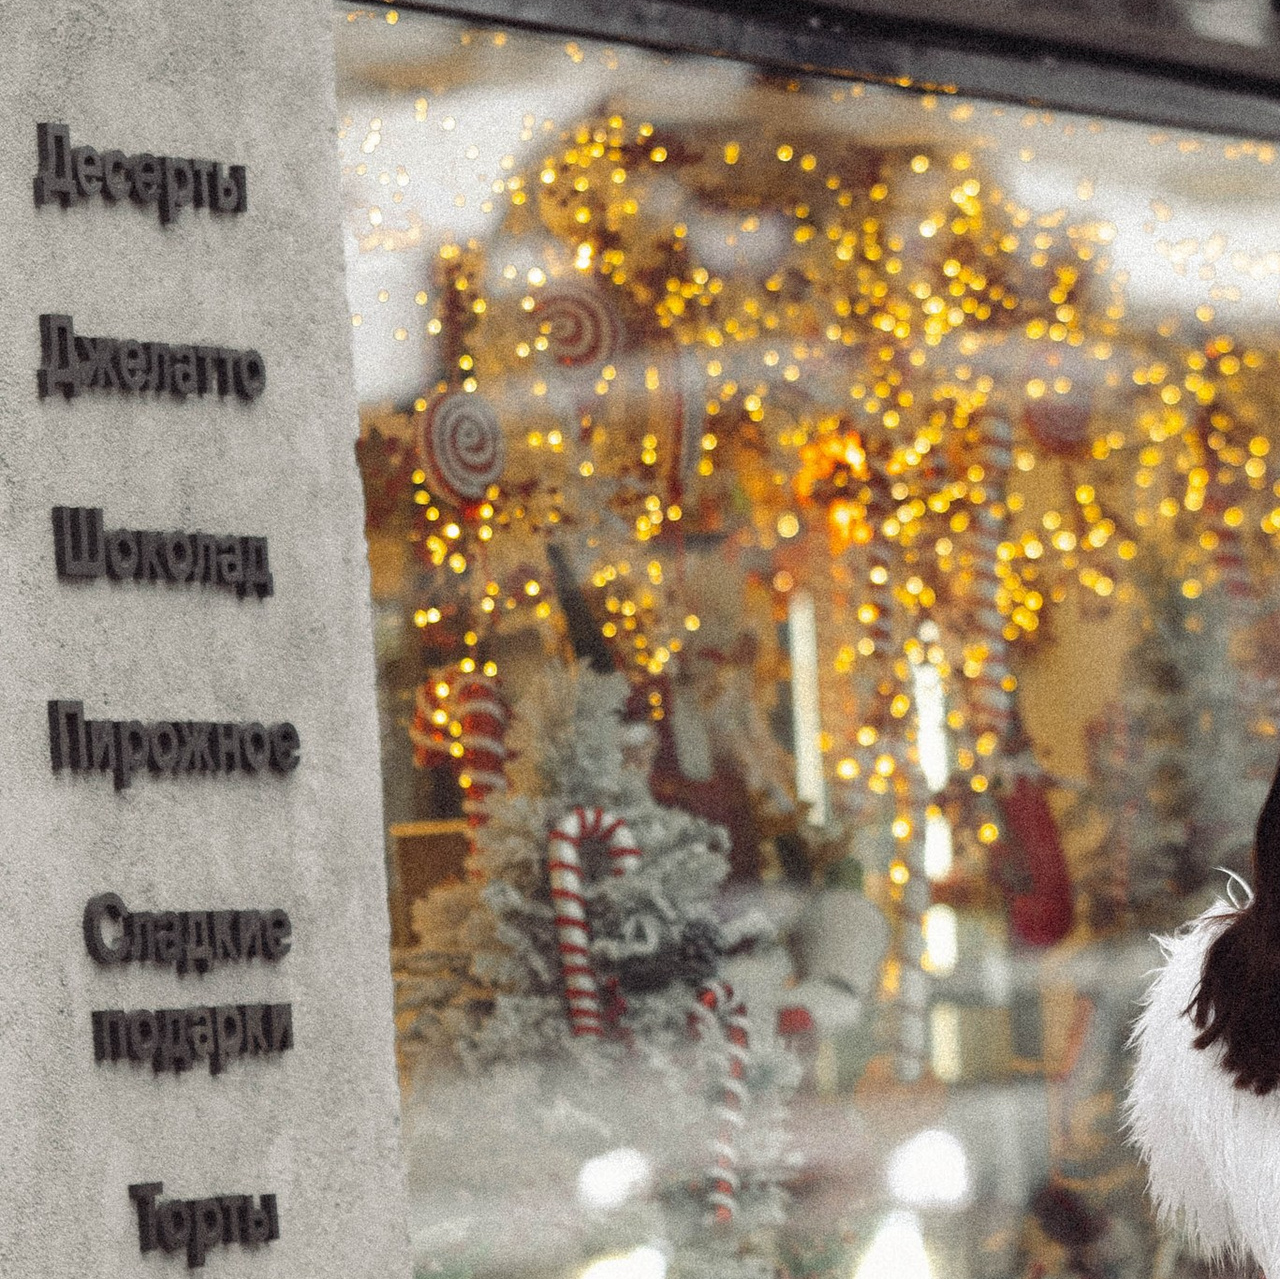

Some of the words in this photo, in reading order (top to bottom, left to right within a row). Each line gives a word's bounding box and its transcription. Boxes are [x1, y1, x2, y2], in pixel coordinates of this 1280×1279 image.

[33, 122, 247, 224] Десерты
[37, 314, 266, 399] Джелатто
[52, 506, 273, 599] Шоколад
[48, 700, 300, 790] Пирожное
[83, 892, 292, 974] Сладкие
[91, 1003, 294, 1076] подарки
[128, 1182, 280, 1269] Торты
